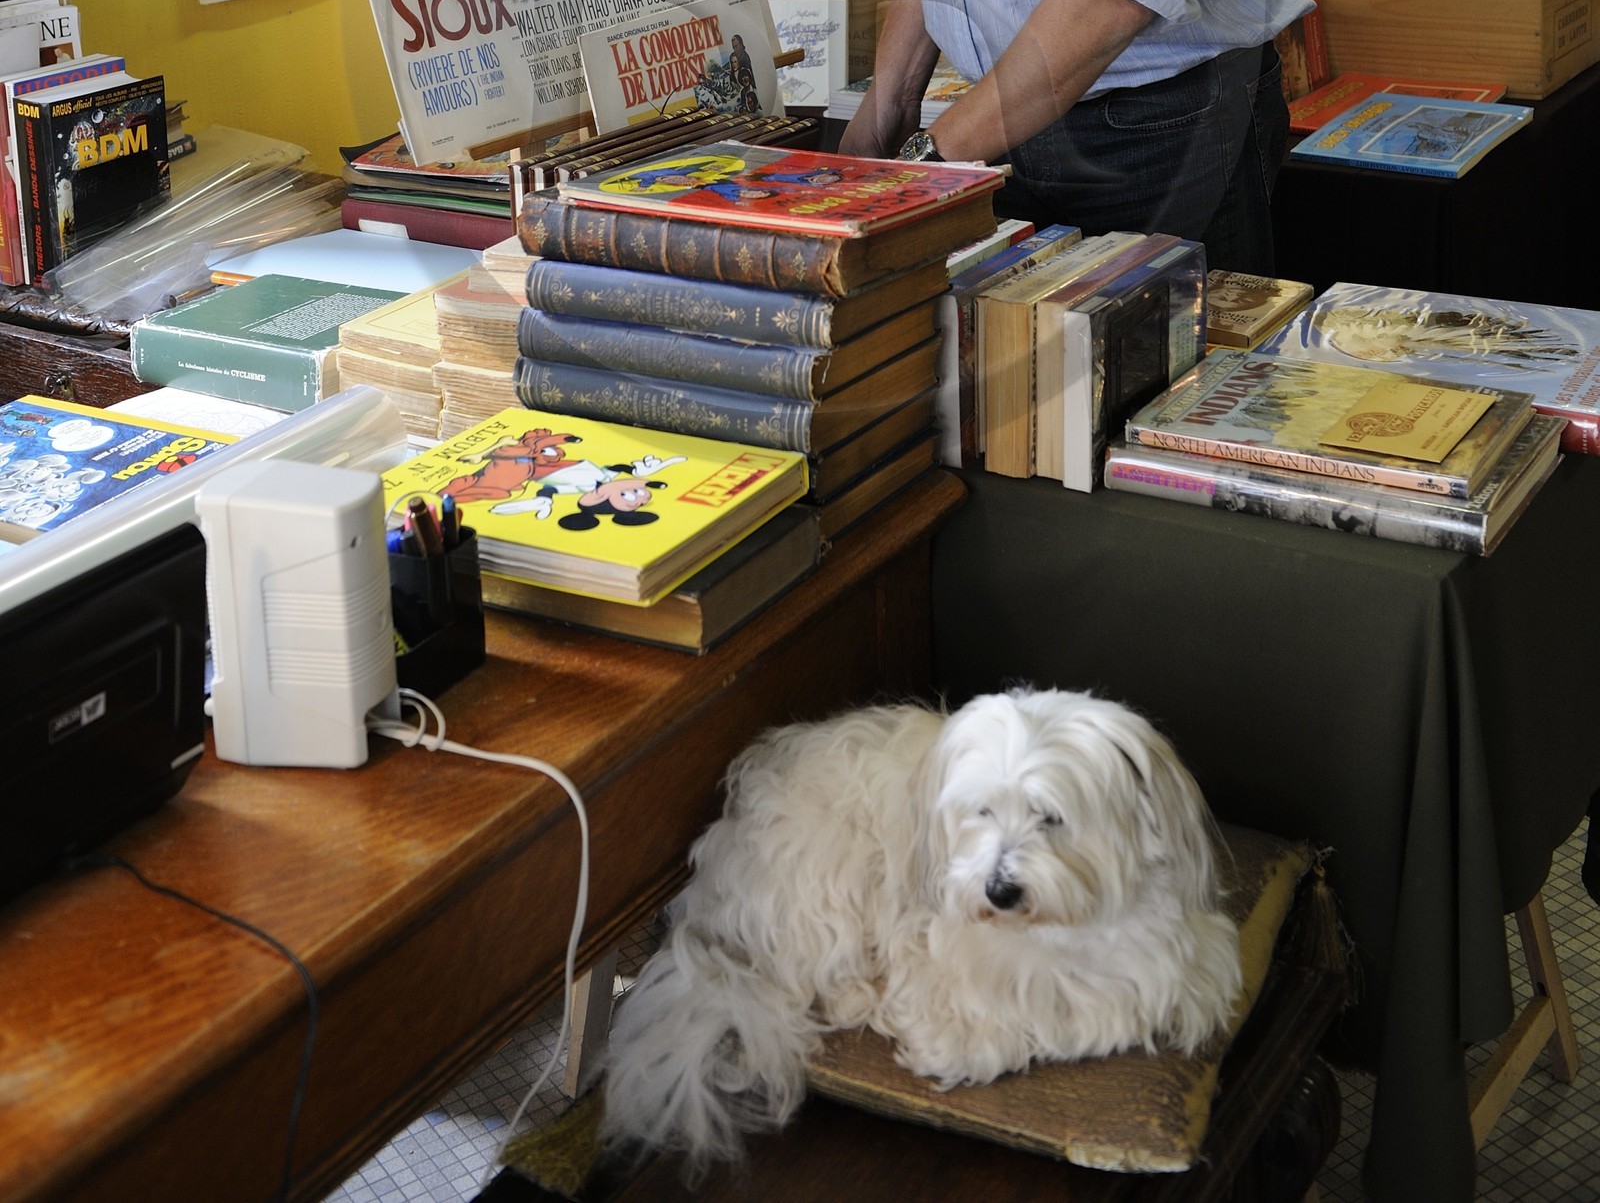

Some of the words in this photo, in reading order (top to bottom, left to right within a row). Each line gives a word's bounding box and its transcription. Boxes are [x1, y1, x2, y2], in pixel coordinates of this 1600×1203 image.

[514, 4, 559, 38] WALTER
[607, 33, 623, 43] BANDE
[624, 25, 651, 39] ORIGINALE
[650, 24, 659, 32] DU
[458, 48, 477, 76] DE
[476, 42, 501, 72] NOS
[521, 38, 537, 57] LON
[610, 40, 642, 76] LA
[639, 14, 725, 67] CONQUÊTE
[529, 61, 553, 81] FRANK
[551, 55, 573, 75] DAVIS
[535, 83, 566, 105] WILLIAM
[618, 72, 648, 109] DE
[17, 102, 40, 119] BDM
[52, 106, 73, 118] ARGUS
[77, 124, 149, 169] BDM
[1419, 168, 1454, 177] CLARENCE
[31, 174, 40, 209] BANDE
[33, 225, 45, 271] TRÉSORS
[178, 361, 186, 369] La
[230, 368, 266, 382] CYCLISME
[1182, 361, 1280, 427] INDIANS
[1407, 389, 1445, 426] POSTCARDS
[432, 420, 510, 460] ALBUM
[1347, 432, 1364, 443] 12
[111, 437, 207, 481] Spirou
[1153, 432, 1208, 454] NORTH
[1212, 444, 1300, 468] AMERICAN
[1304, 460, 1376, 481] INDIANS
